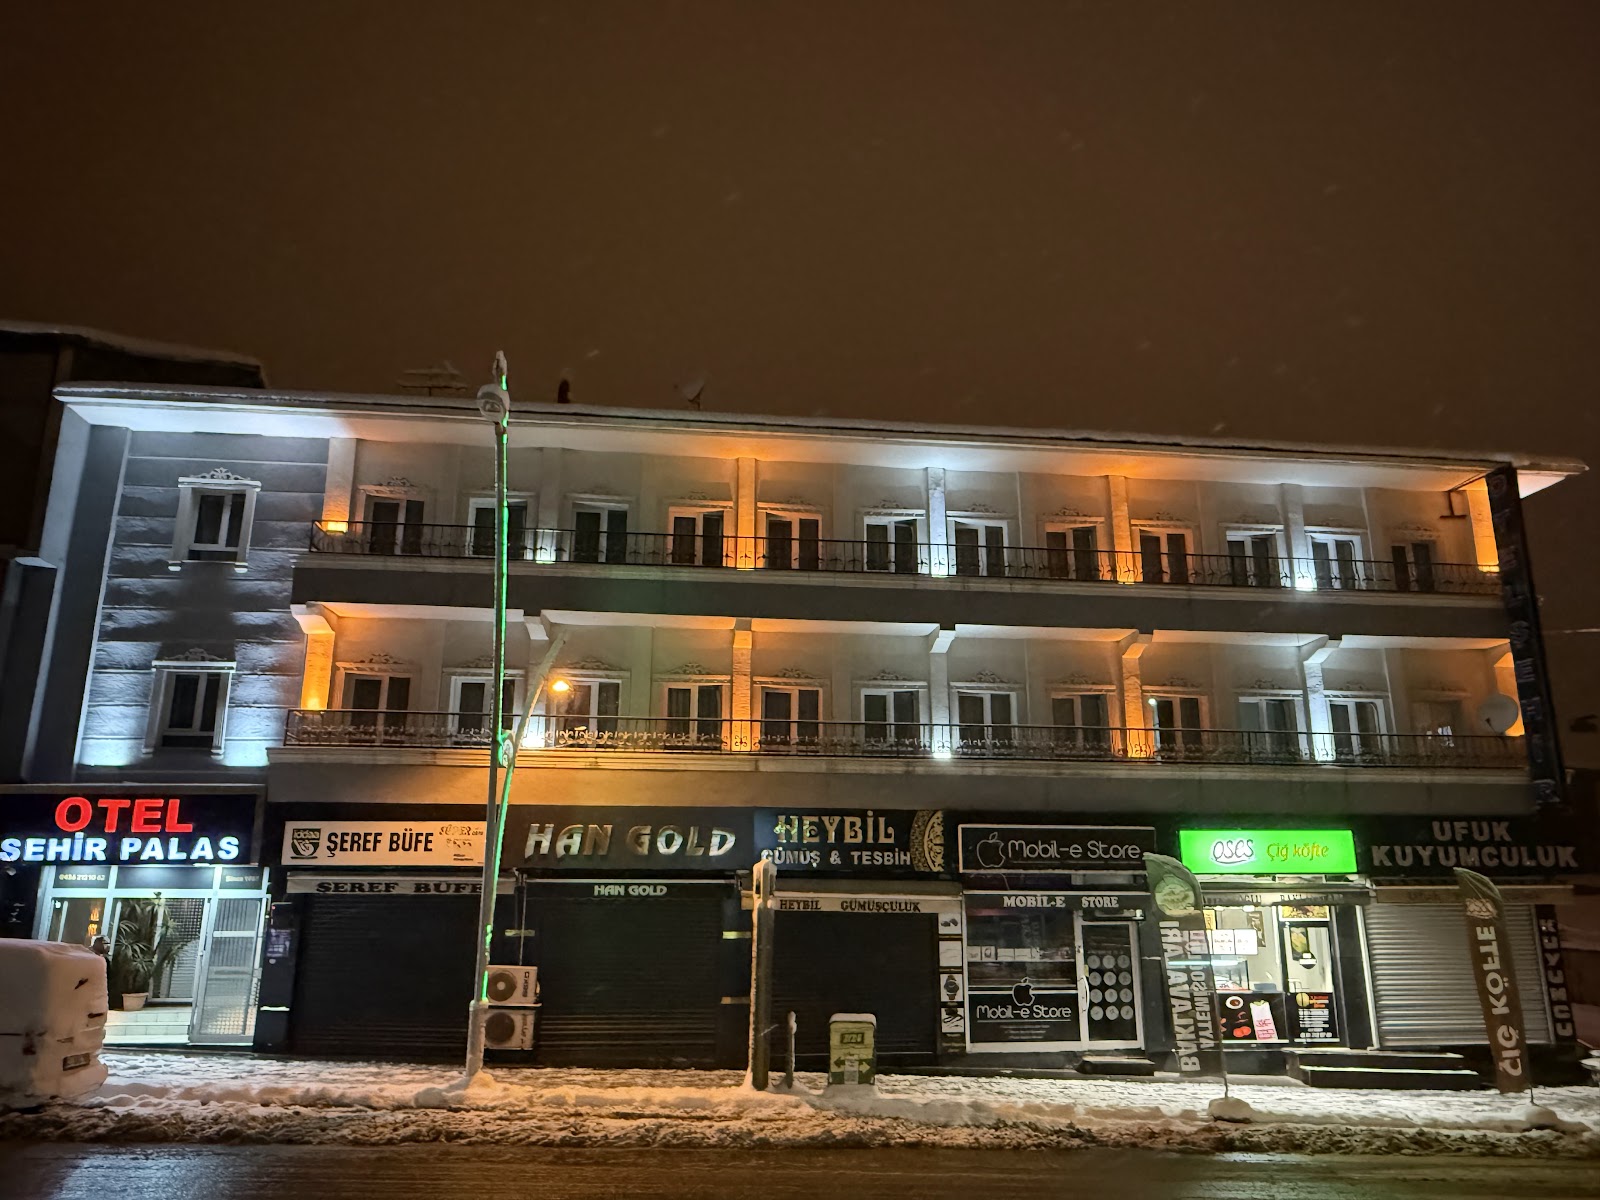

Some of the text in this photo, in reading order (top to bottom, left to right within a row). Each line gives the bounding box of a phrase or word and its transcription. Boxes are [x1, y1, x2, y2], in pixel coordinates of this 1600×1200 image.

[55, 796, 193, 833] OTEL
[774, 810, 895, 844] HEYBİL
[1431, 820, 1513, 842] UFUK
[119, 836, 240, 861] PALAS
[326, 832, 383, 858] ŞEREF
[389, 828, 434, 852] BÜFE
[524, 823, 736, 859] HAN GOLD
[1008, 840, 1141, 859] Mobil-e Store
[829, 850, 842, 865] &
[851, 847, 911, 866] TESBİH
[1370, 845, 1579, 868] KUYUMCULUK
[593, 885, 668, 896] HAN GOLD
[1081, 896, 1119, 908] STORE
[1539, 918, 1573, 1037] KUYUMCU
[976, 1004, 1072, 1019] Mobil-e Store
